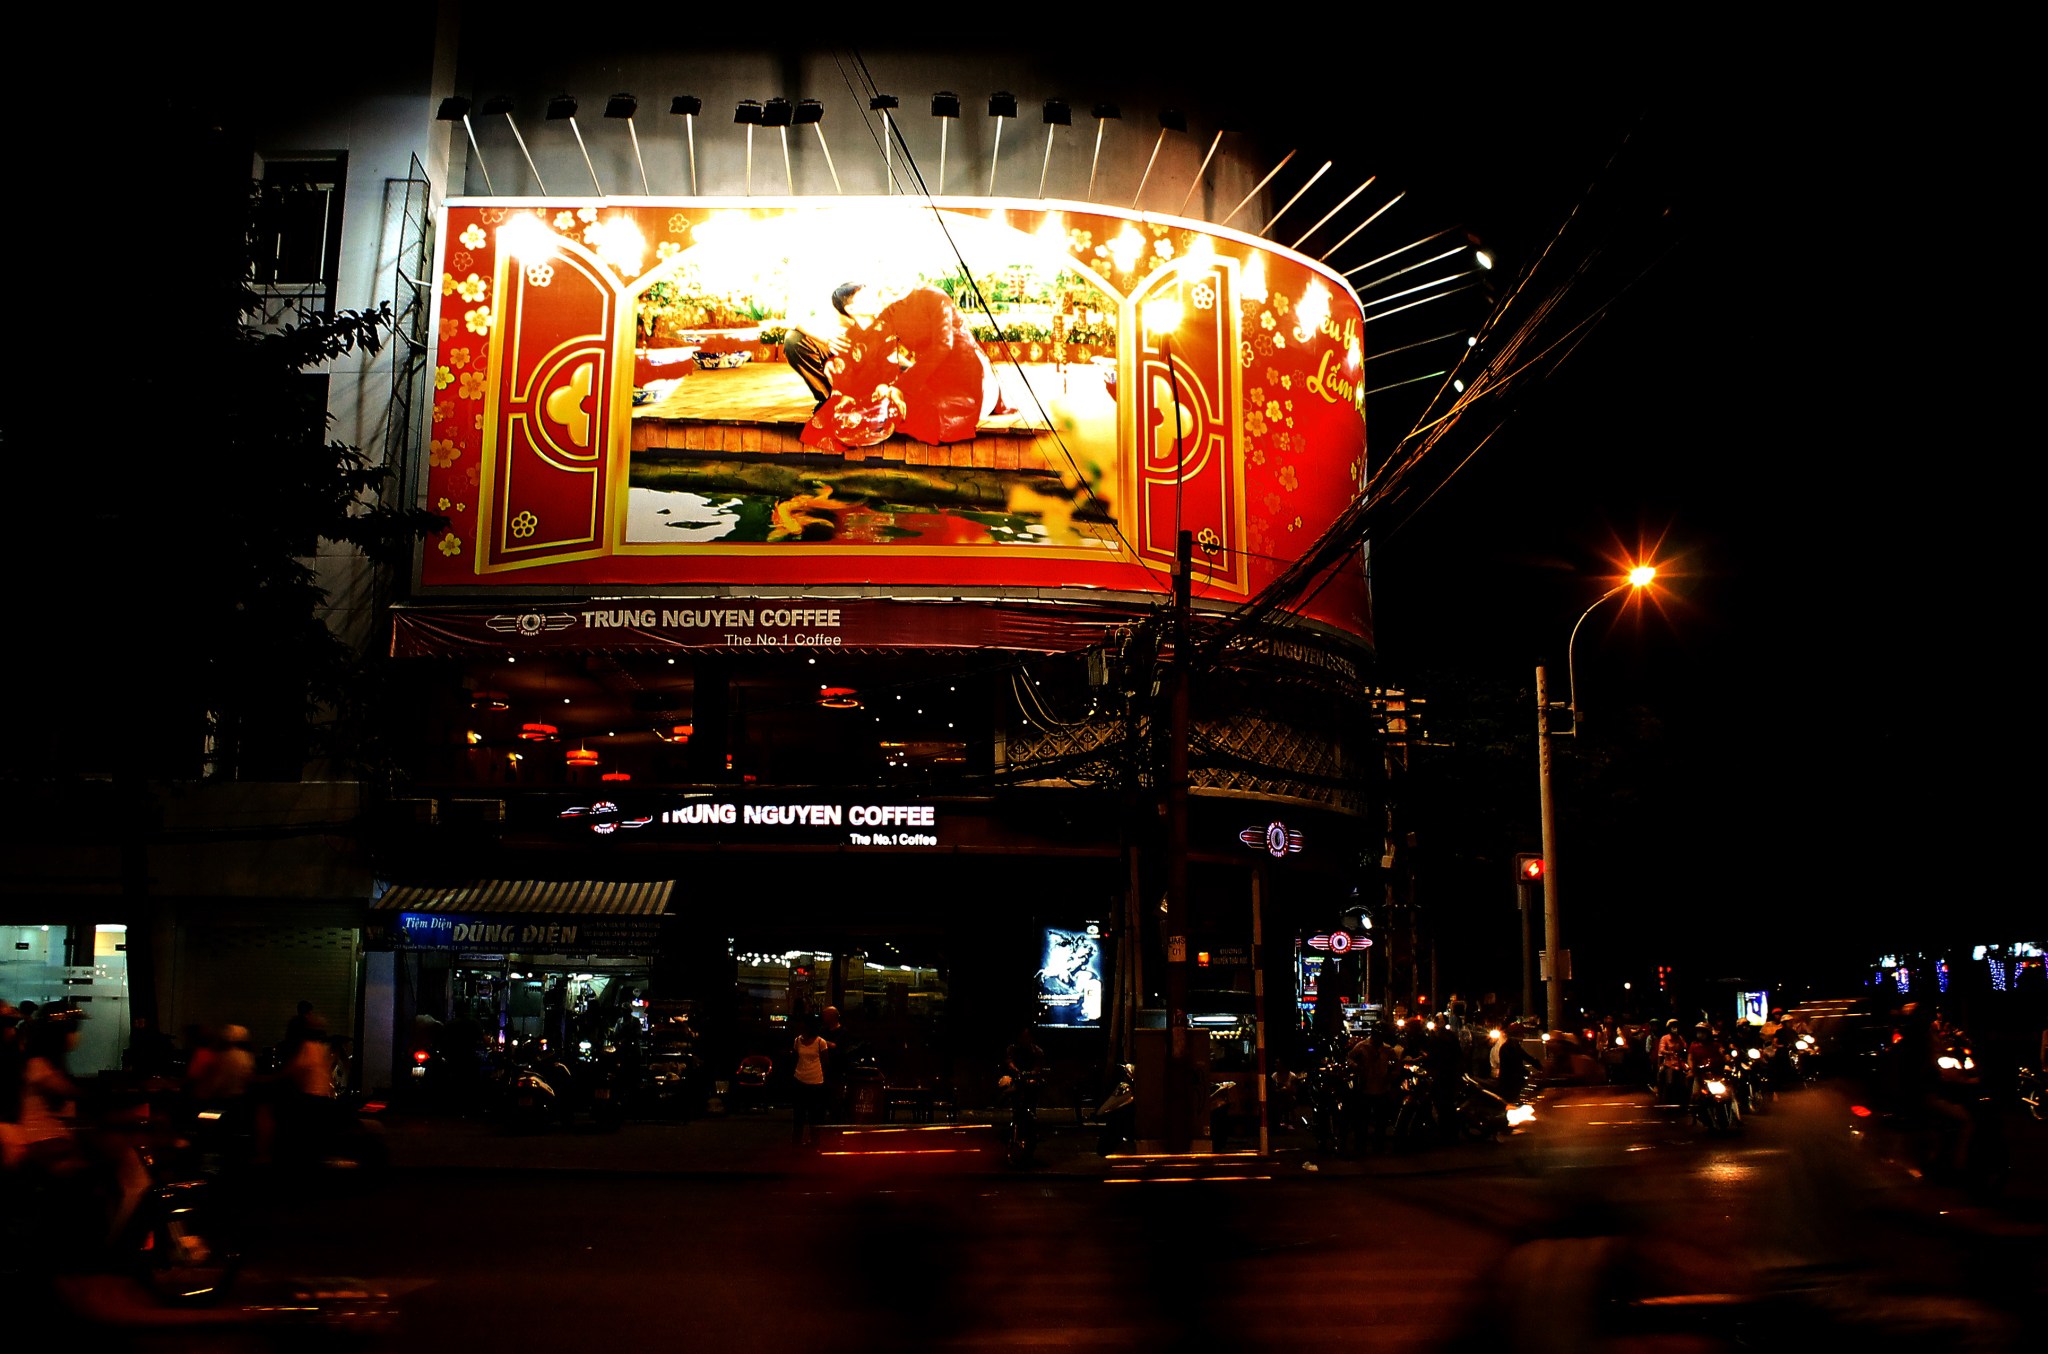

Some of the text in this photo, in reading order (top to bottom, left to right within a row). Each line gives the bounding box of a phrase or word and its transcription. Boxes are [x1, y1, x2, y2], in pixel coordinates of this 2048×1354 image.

[582, 608, 841, 628] TRUNG NGUYEN COFFEE
[724, 633, 842, 646] The No.1 Coffee
[744, 805, 842, 825] NGUYEN
[849, 806, 935, 826] COFFEE
[849, 833, 938, 847] The No.1 Coffee
